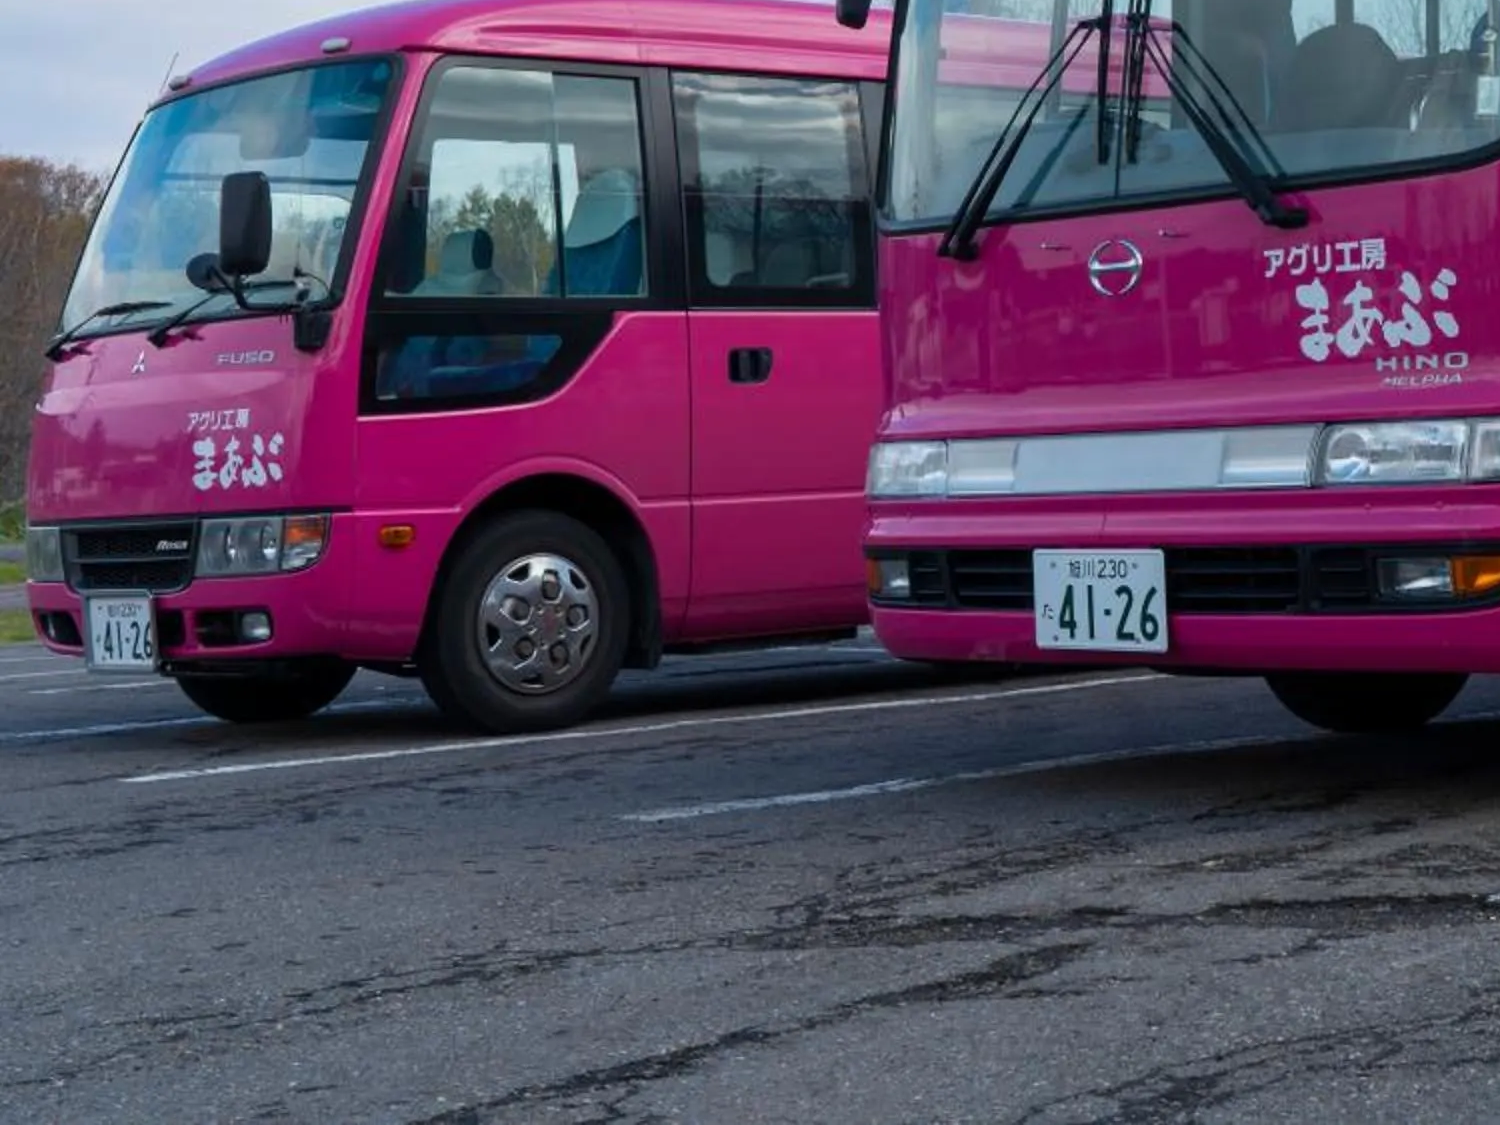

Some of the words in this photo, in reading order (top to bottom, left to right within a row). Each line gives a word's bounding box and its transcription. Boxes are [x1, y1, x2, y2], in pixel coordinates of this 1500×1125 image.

[1263, 238, 1386, 277] アグリ工房
[1295, 268, 1459, 361] まあぶ
[217, 350, 274, 364] FUSO
[1376, 352, 1468, 371] HINO
[187, 408, 250, 432] アグリ工房
[192, 431, 284, 491] まあぶ
[1059, 584, 1158, 642] 41-26
